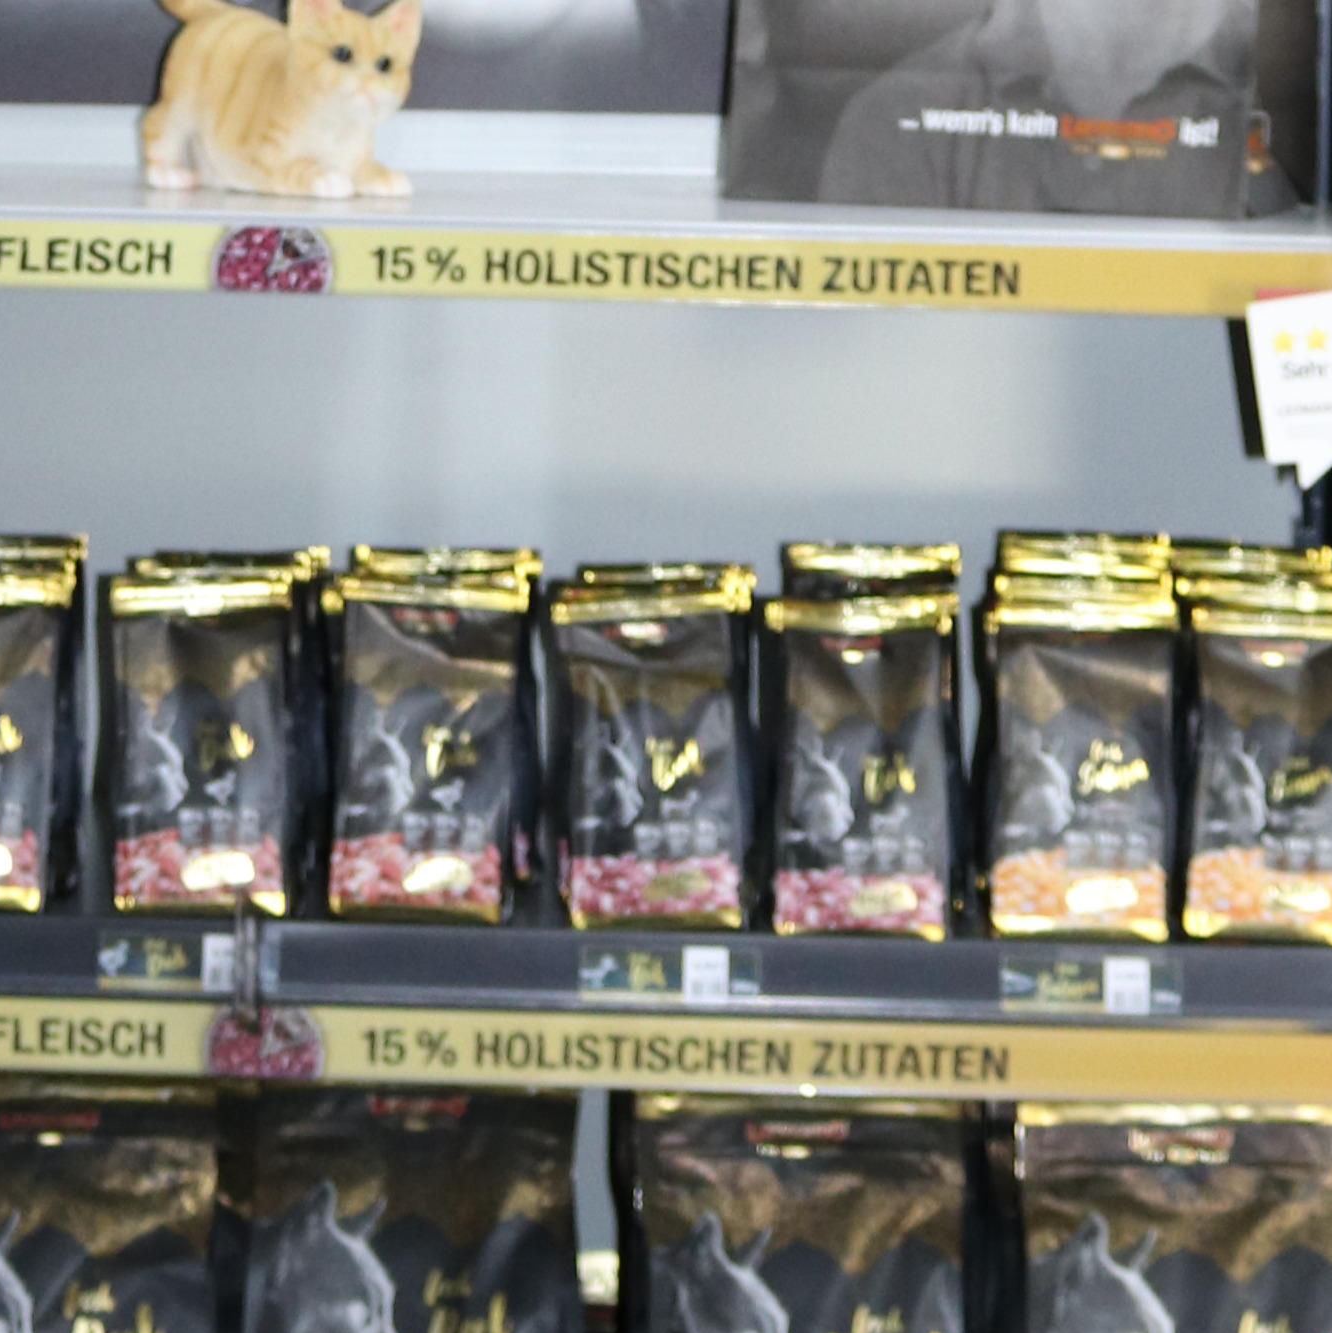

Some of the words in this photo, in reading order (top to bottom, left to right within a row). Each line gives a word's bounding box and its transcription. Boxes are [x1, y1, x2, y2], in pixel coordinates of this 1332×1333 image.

[372, 246, 416, 284] 15
[485, 249, 803, 293] HOLISTISCHEN
[822, 257, 1021, 299] ZUTATEN
[1282, 358, 1329, 380] Sehr
[364, 1028, 408, 1067] 15
[475, 1032, 794, 1078] HOLISTISCHEN
[811, 1040, 1011, 1083] ZUTATEN
